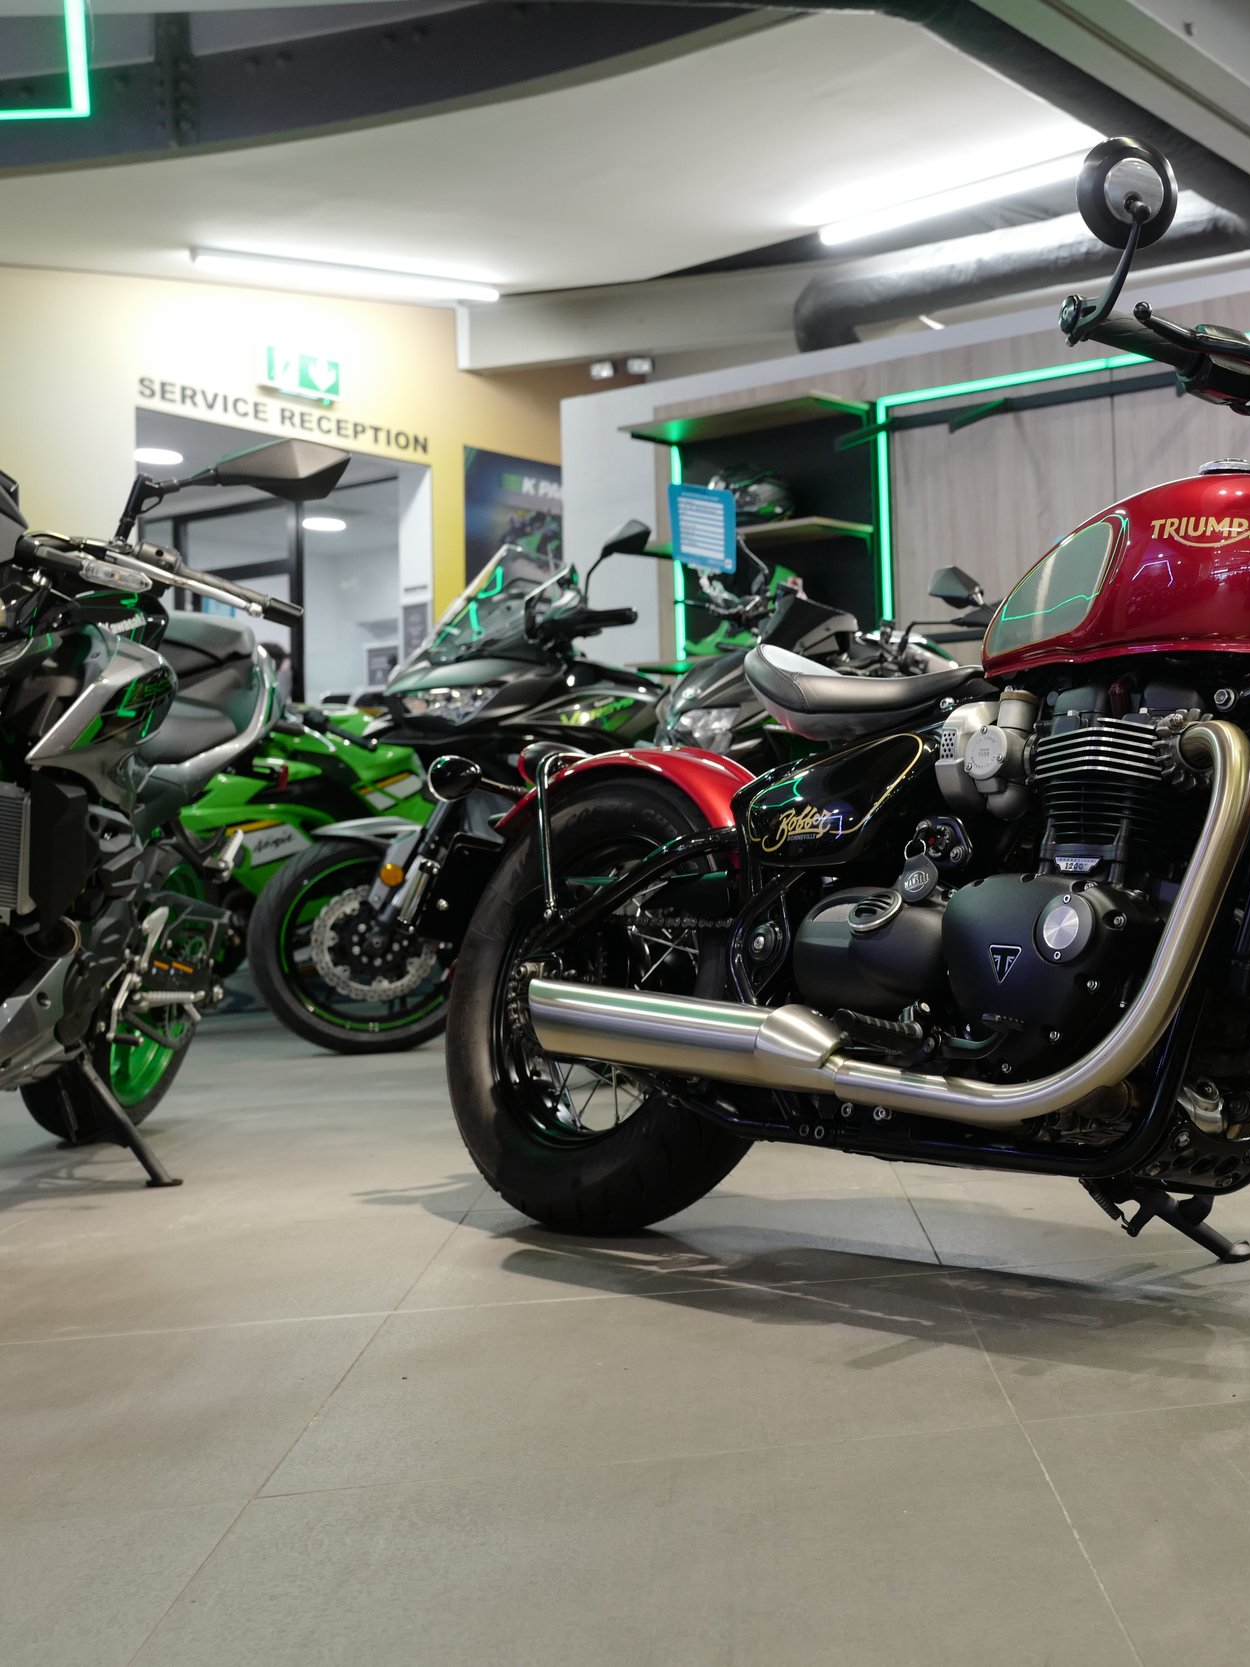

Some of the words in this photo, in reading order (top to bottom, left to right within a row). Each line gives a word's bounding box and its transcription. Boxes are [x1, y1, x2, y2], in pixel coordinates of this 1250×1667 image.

[138, 377, 269, 422] SERVICE
[279, 407, 429, 454] RECEPTION
[1065, 862, 1083, 870] 1200
